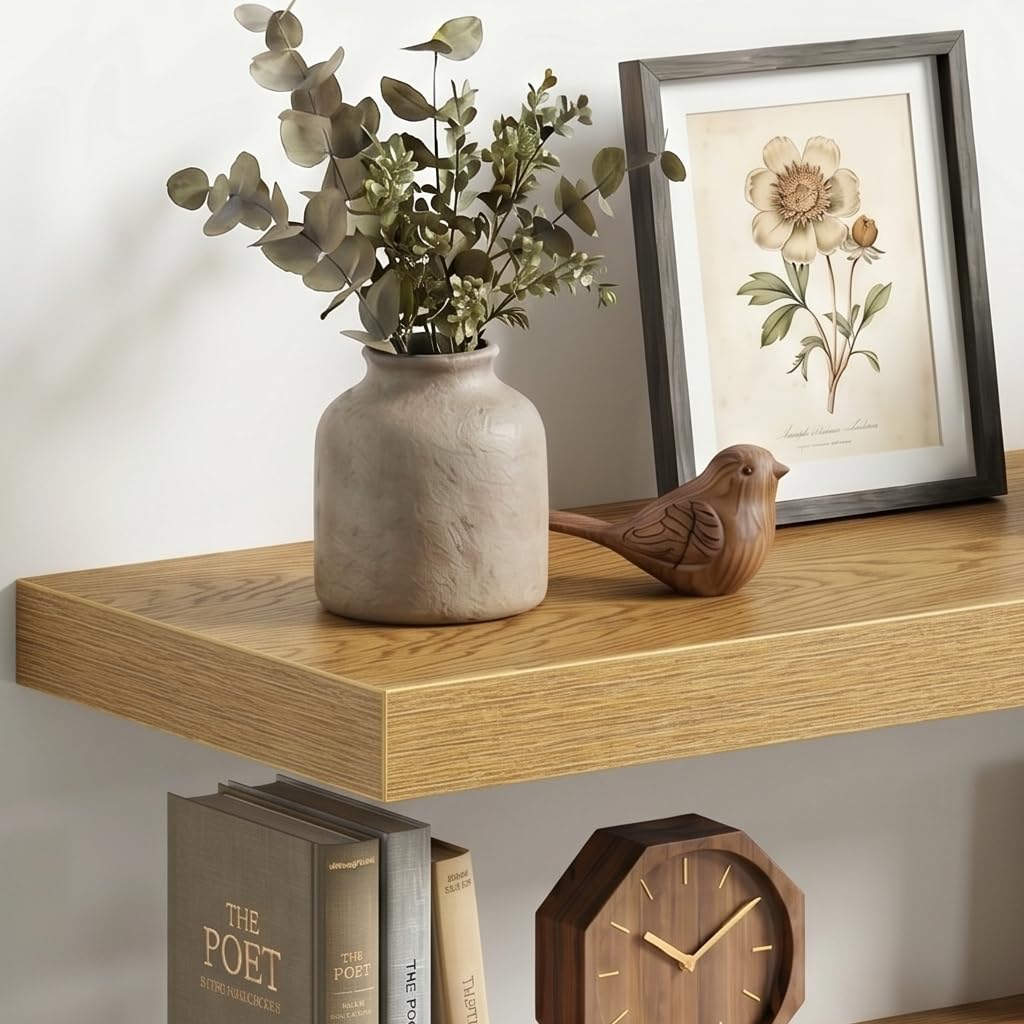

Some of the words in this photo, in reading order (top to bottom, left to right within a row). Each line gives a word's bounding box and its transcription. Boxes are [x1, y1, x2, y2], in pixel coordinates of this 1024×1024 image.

[226, 902, 259, 935] THE
[203, 926, 281, 992] POET
[334, 963, 371, 980] POET
[341, 951, 363, 963] THE
[406, 959, 416, 992] THE
